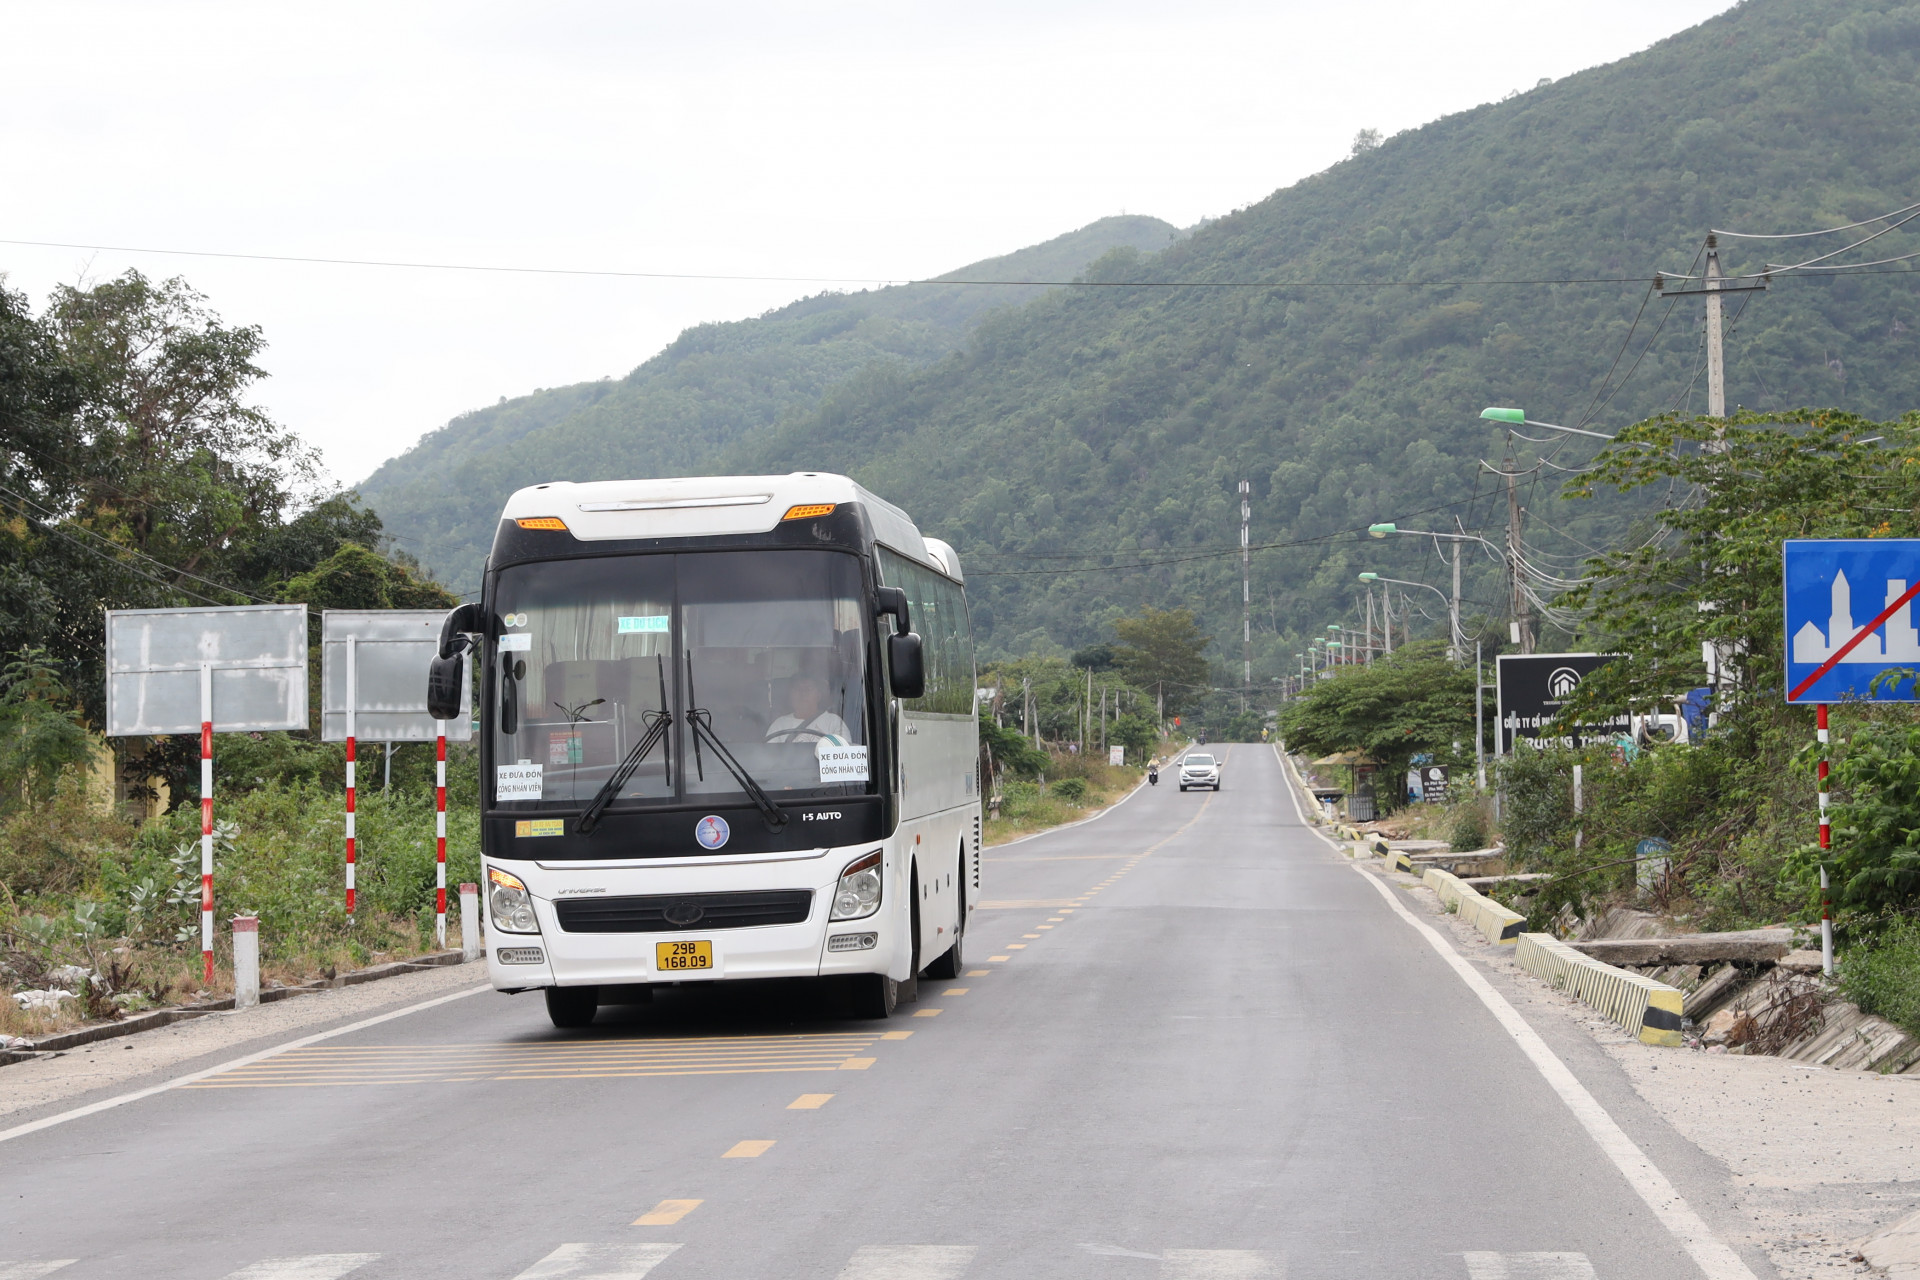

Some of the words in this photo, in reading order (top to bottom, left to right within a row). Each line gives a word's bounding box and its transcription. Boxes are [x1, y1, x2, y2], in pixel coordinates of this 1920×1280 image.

[1504, 716, 1521, 728] CÔG
[1522, 717, 1530, 728] TY
[821, 753, 831, 761] XE
[833, 752, 849, 760] ĐƯA
[821, 764, 837, 775] CÔNG
[838, 763, 854, 773] NHÂN
[854, 763, 868, 774] VIÊN
[499, 772, 508, 780] XE
[498, 783, 512, 794] CÔNG
[512, 782, 528, 793] NHÂN
[816, 811, 842, 820] AUTO
[672, 943, 696, 955] 29B
[664, 955, 706, 969] 168.09
